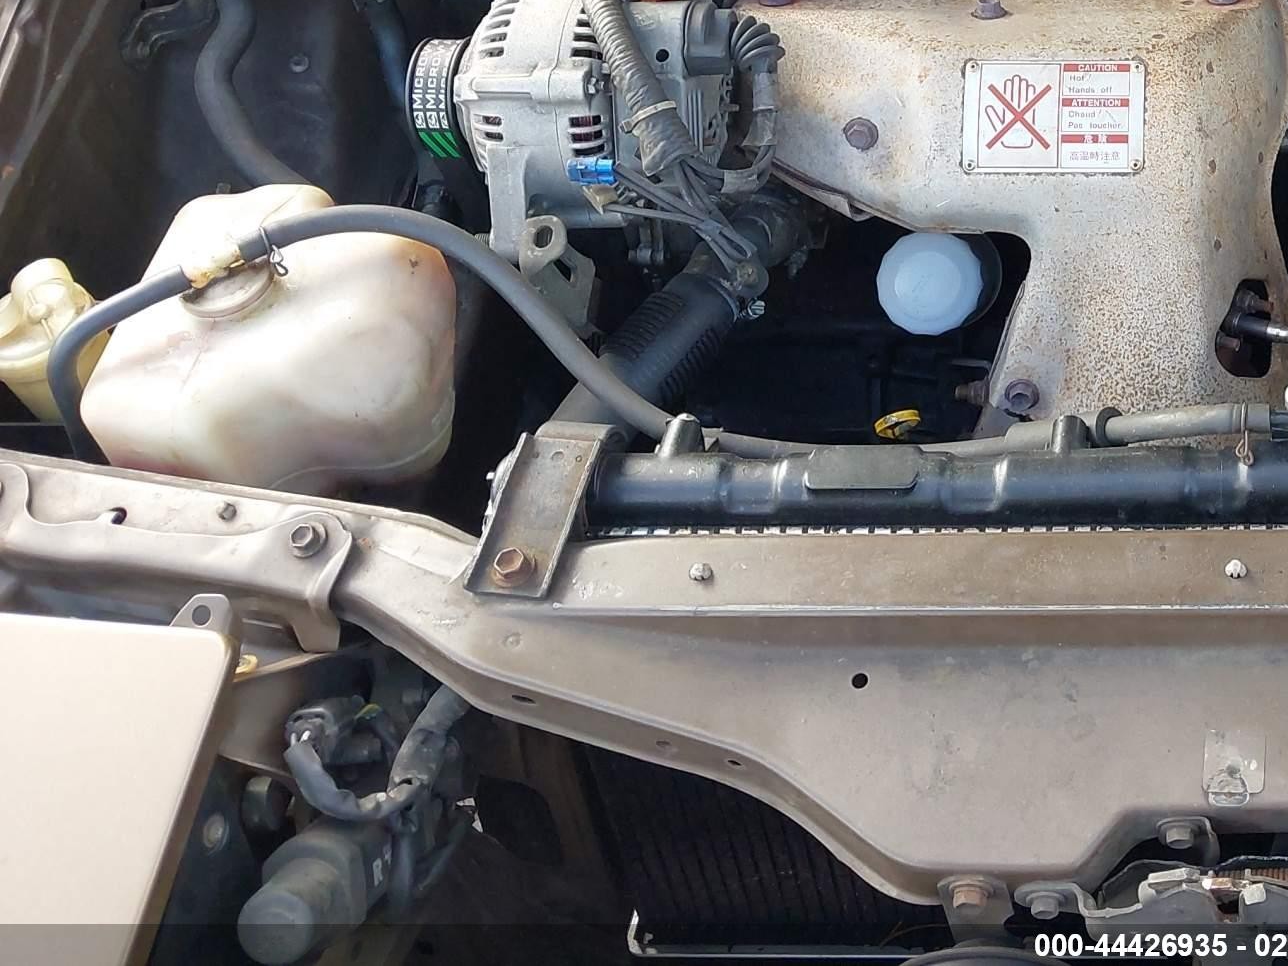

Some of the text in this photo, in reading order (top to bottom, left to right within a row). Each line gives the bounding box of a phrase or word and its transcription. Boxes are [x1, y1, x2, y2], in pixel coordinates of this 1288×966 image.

[1078, 64, 1118, 72] CAUTION
[1068, 86, 1113, 94] Hands off
[1071, 99, 1121, 107] ATTENTION
